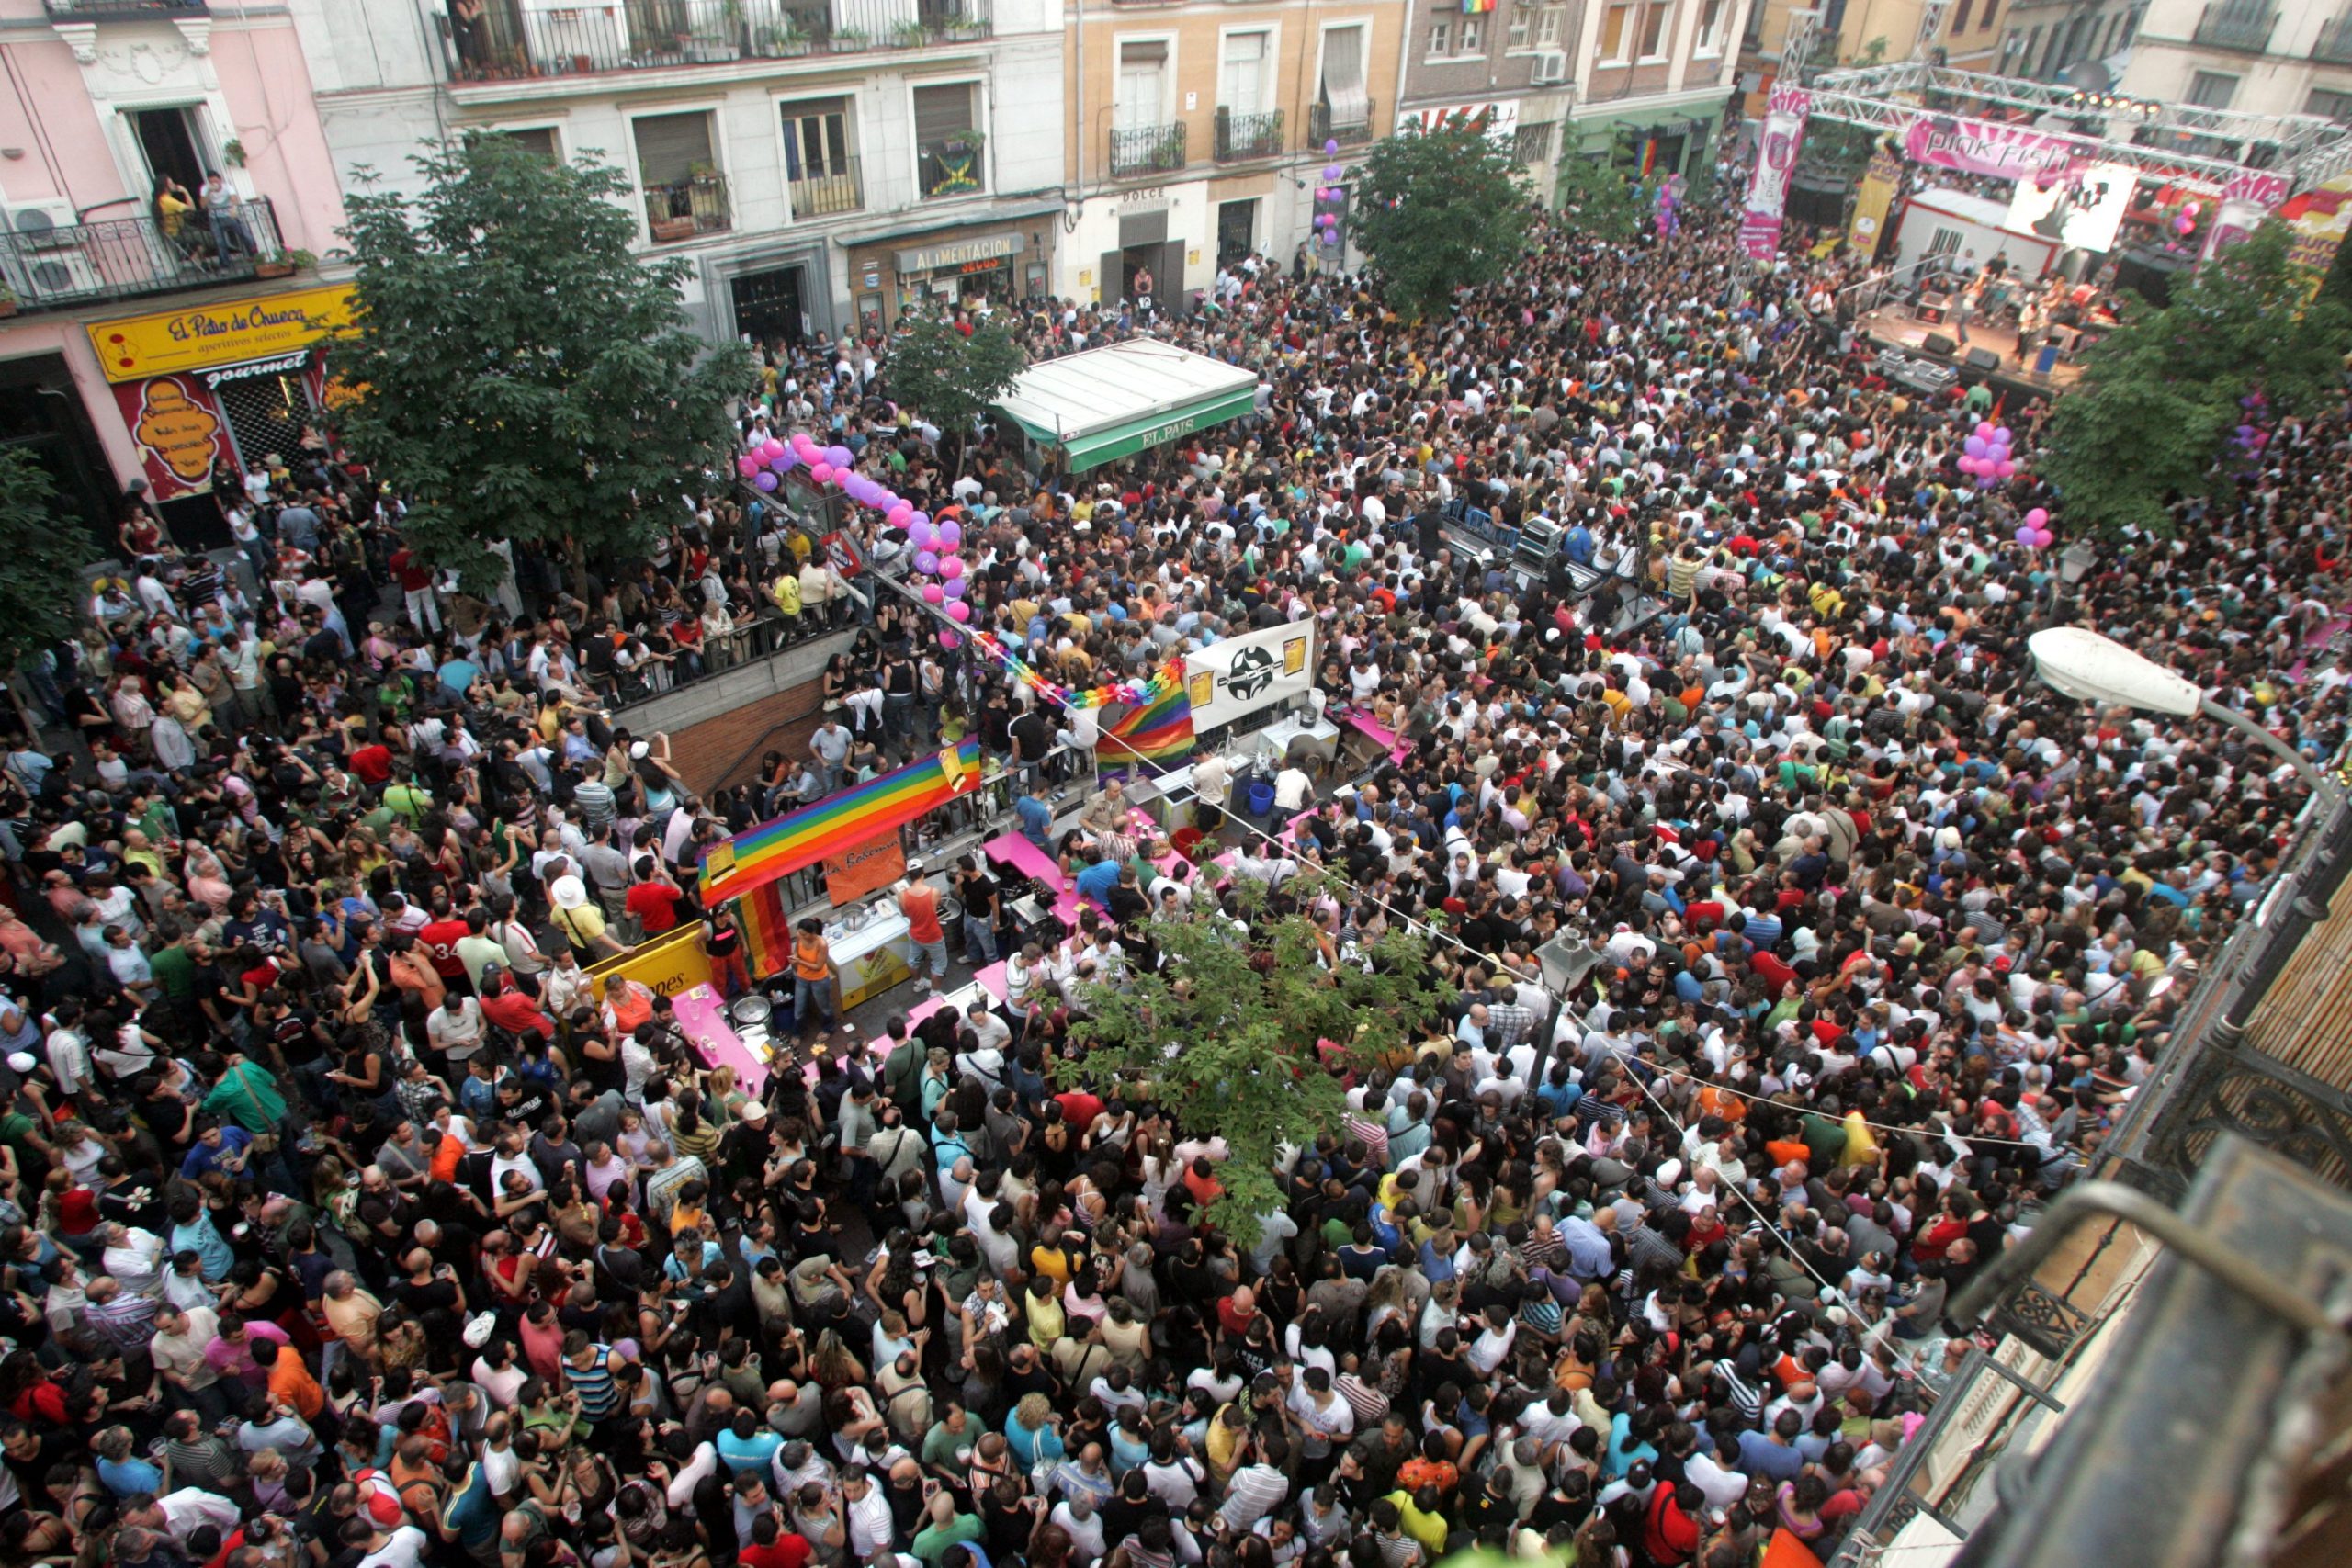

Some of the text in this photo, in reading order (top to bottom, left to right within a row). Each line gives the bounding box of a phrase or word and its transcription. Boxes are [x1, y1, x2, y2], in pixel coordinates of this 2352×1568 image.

[1926, 130, 2070, 172] pink fish
[1123, 186, 1164, 202] DOLCE
[168, 317, 190, 341] El
[249, 305, 307, 328] Chueca
[198, 336, 251, 355] aperitivos
[254, 330, 292, 344] selectos
[206, 352, 307, 389] gourmet
